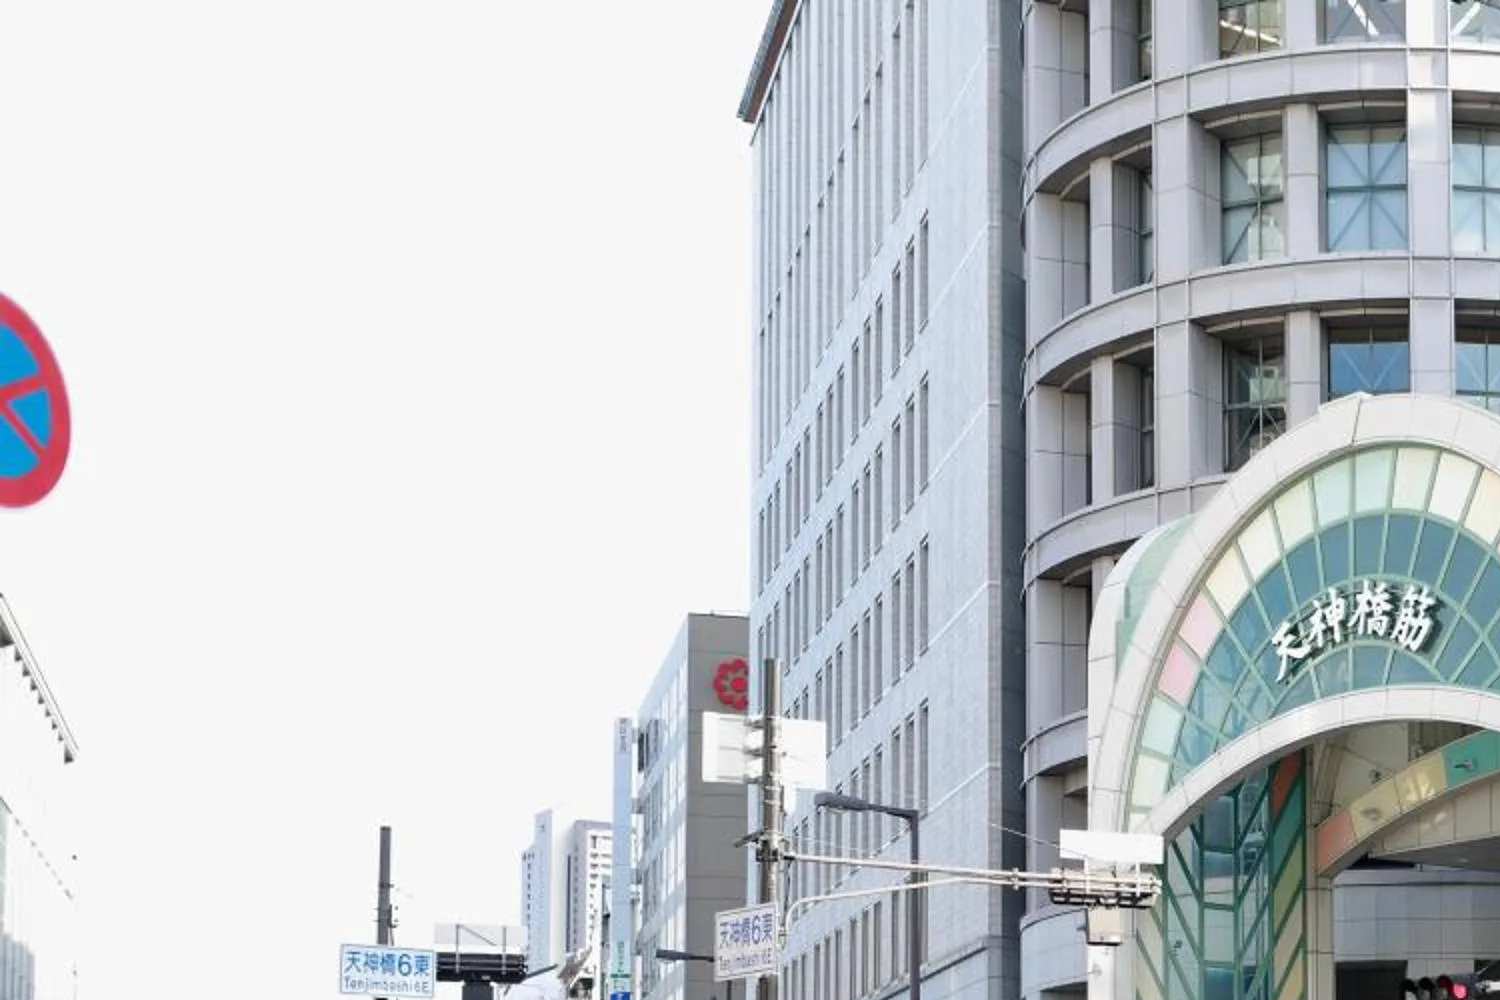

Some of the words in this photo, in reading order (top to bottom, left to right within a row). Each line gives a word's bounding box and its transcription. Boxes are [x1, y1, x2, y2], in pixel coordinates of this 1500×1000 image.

[1272, 579, 1436, 684] 天神橋筋
[344, 951, 430, 976] 天神橋6東
